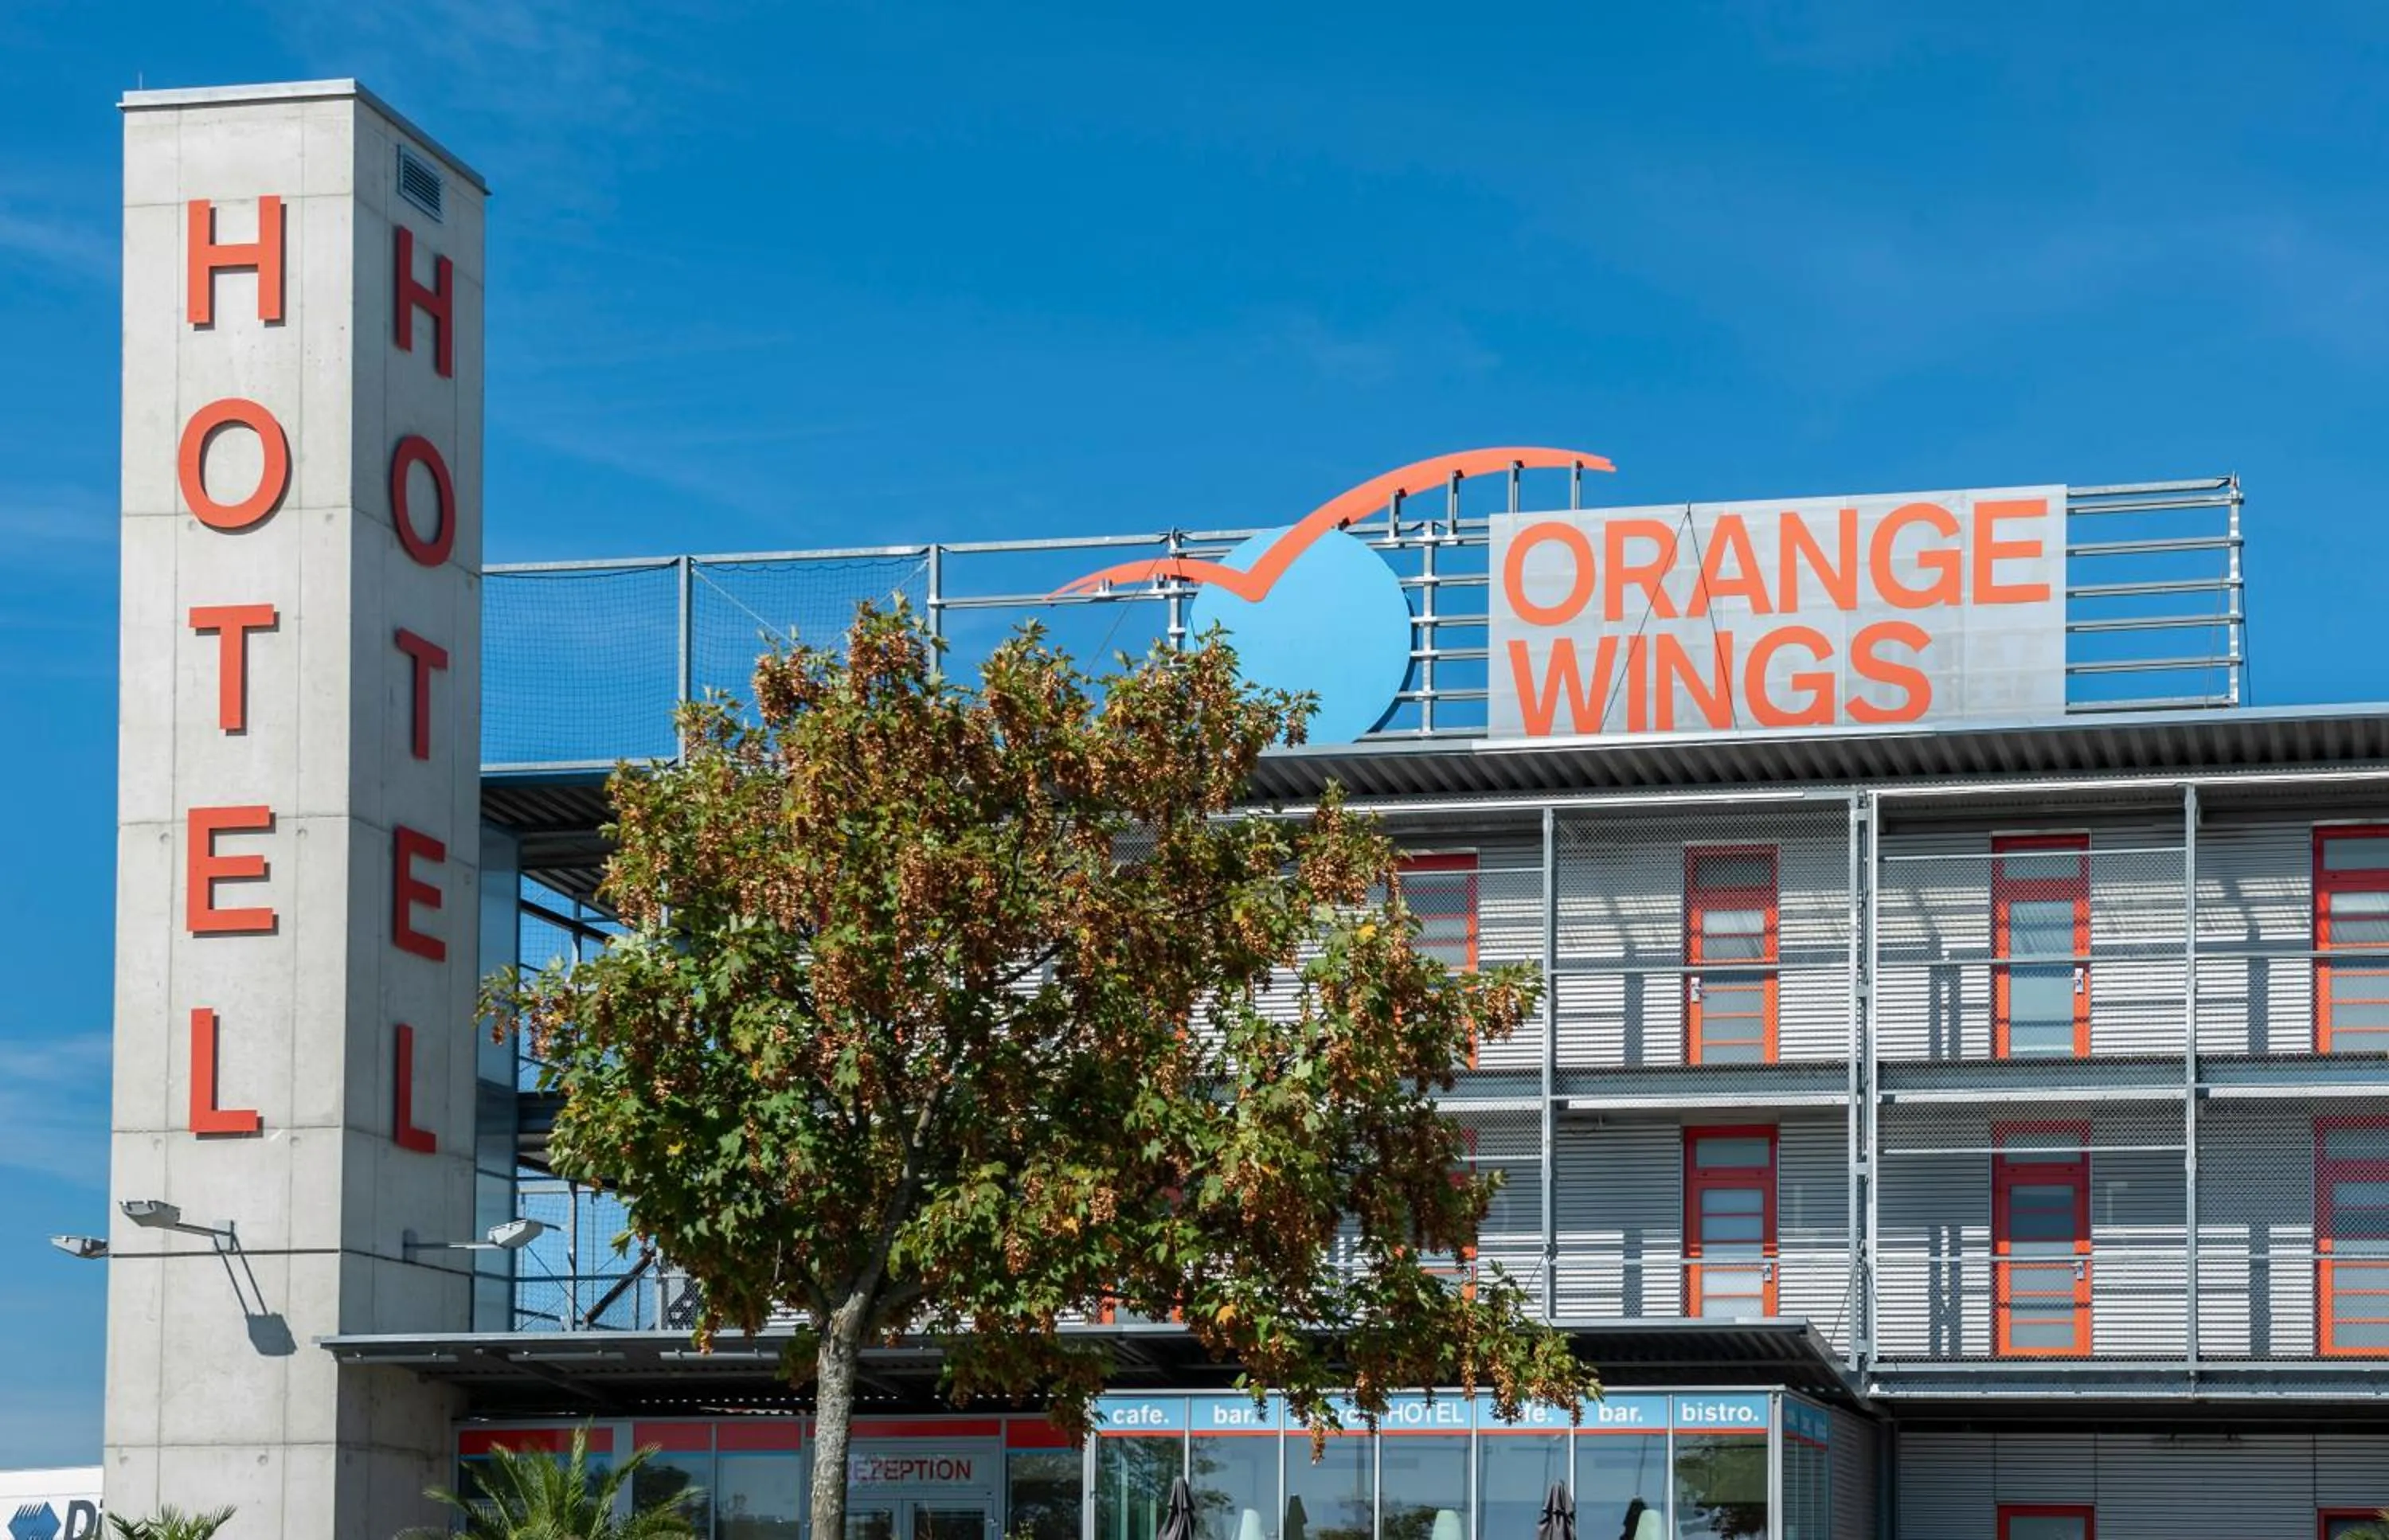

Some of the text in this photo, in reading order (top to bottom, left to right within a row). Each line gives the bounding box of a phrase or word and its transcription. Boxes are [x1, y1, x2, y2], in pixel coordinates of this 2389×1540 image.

[1503, 498, 2051, 627] ORANGE
[178, 195, 287, 1132] HOTEL
[392, 225, 456, 1154] HOTEL
[1507, 620, 1933, 737] WINGS
[848, 1459, 972, 1481] EZEPTION
[1112, 1405, 1169, 1425] cafe.
[1213, 1404, 1256, 1425] bar.
[1387, 1401, 1464, 1424] HOTEL
[1598, 1403, 1644, 1423] bar.
[1681, 1402, 1760, 1422] bistro.
